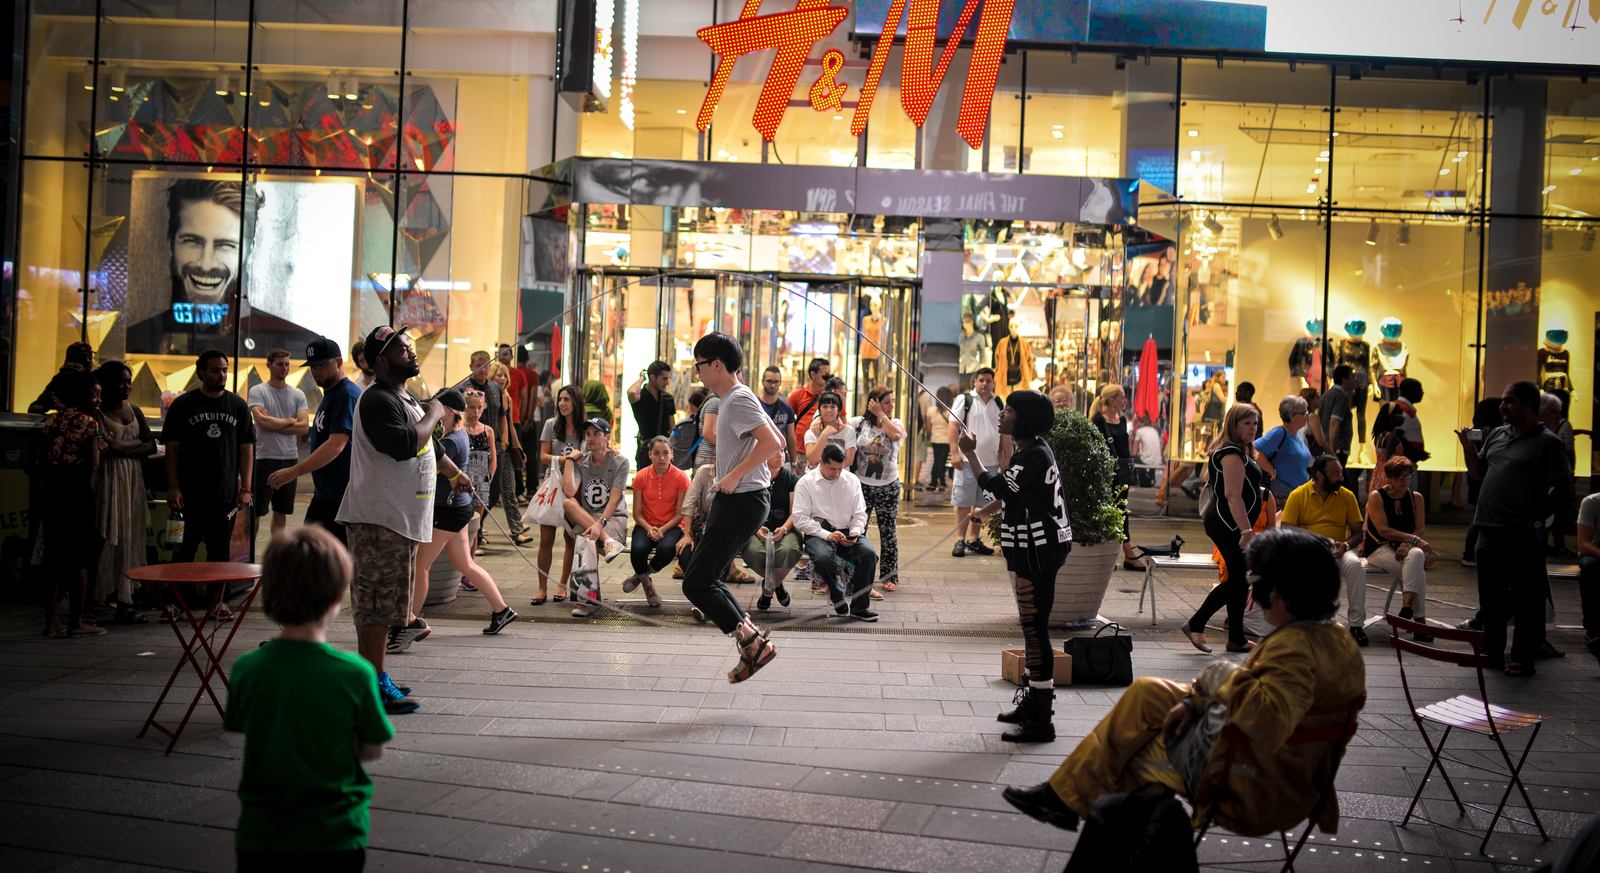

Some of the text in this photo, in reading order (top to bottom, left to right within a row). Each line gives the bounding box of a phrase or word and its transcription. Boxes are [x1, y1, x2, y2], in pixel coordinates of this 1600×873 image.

[696, 0, 1016, 150] H&M
[188, 412, 238, 428] EXPEDITION
[592, 486, 602, 504] 2
